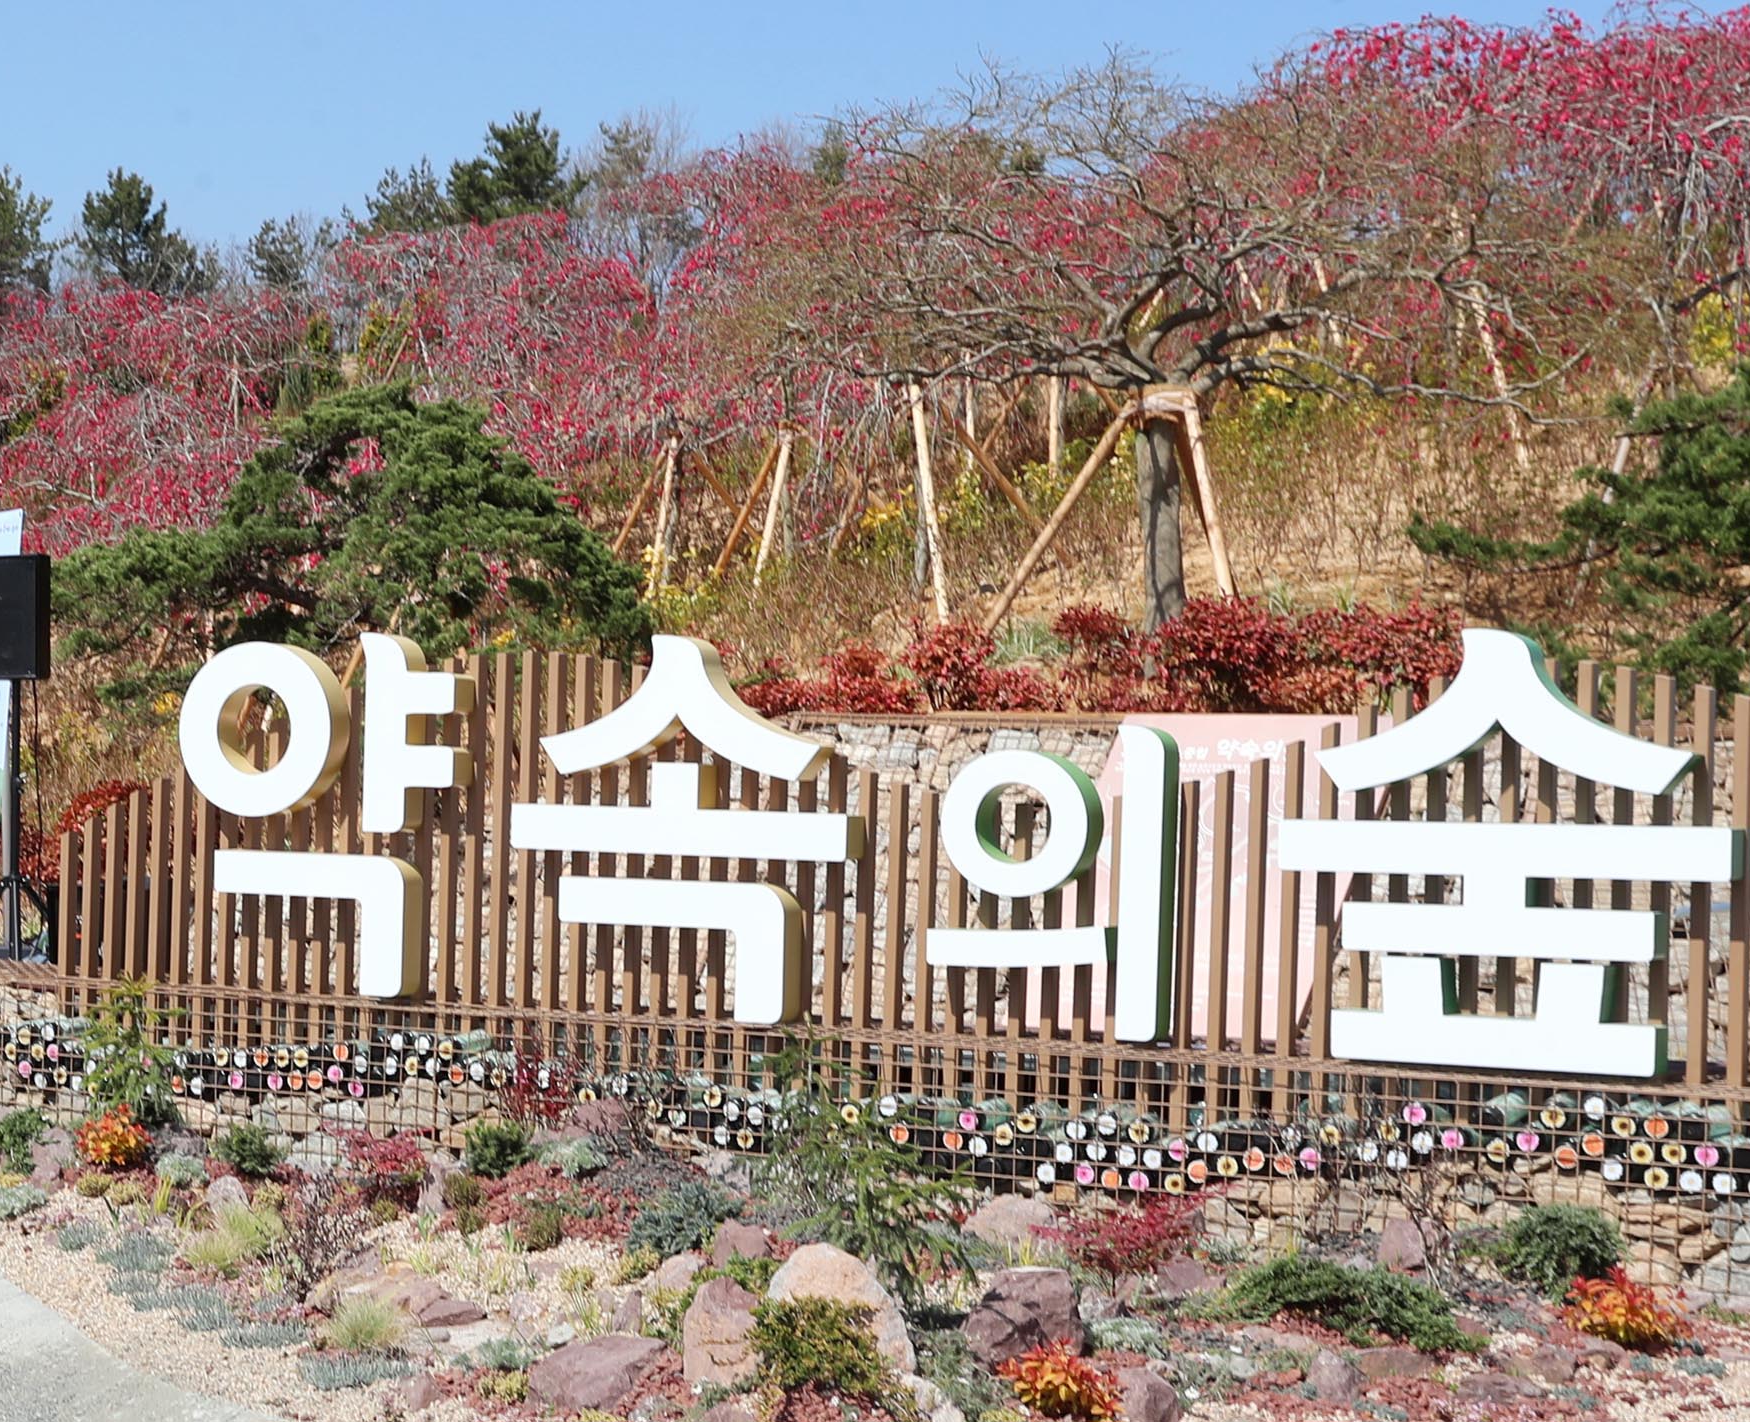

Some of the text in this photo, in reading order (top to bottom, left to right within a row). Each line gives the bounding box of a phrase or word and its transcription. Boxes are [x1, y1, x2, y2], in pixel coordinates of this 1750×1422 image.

[179, 628, 1745, 1078] 약속의 숲
[1217, 738, 1284, 762] 약속의
